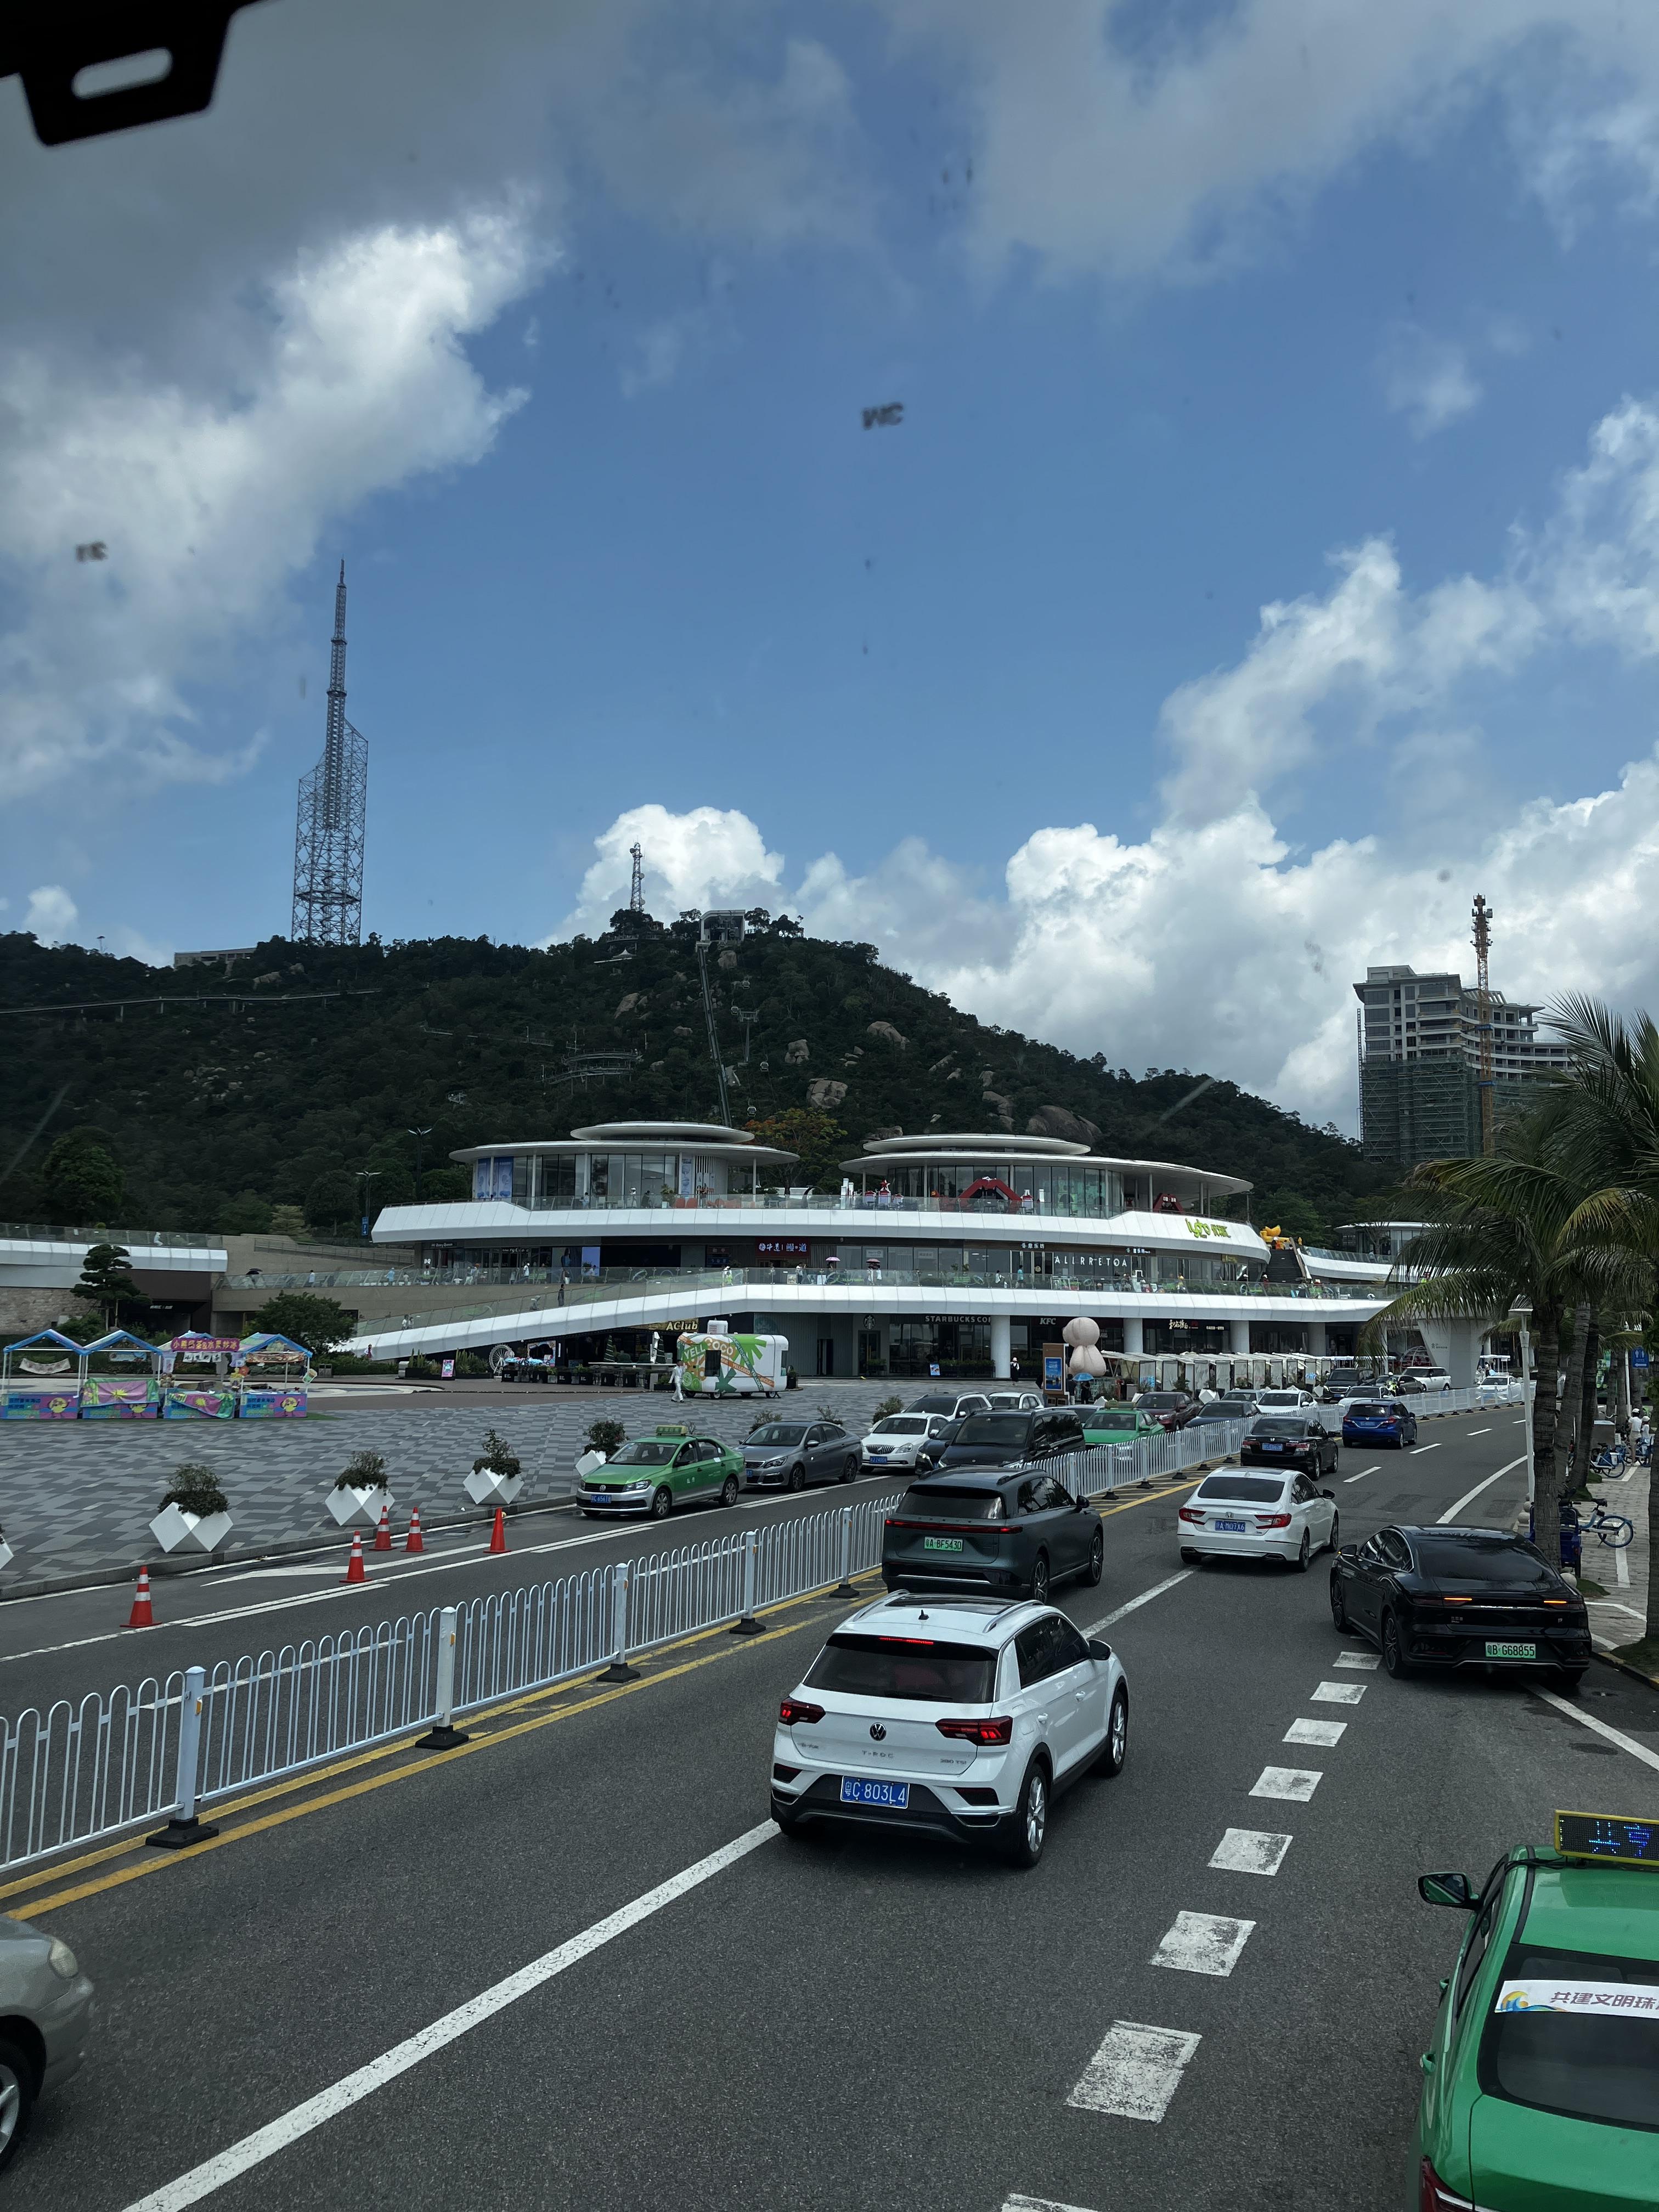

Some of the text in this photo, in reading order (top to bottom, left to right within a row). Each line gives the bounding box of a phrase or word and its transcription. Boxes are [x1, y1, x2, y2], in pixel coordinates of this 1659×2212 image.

[665, 1321, 698, 1331] AClub
[684, 1337, 733, 1359] YELL COCO
[1550, 1991, 1659, 2011] 共建文明珠
